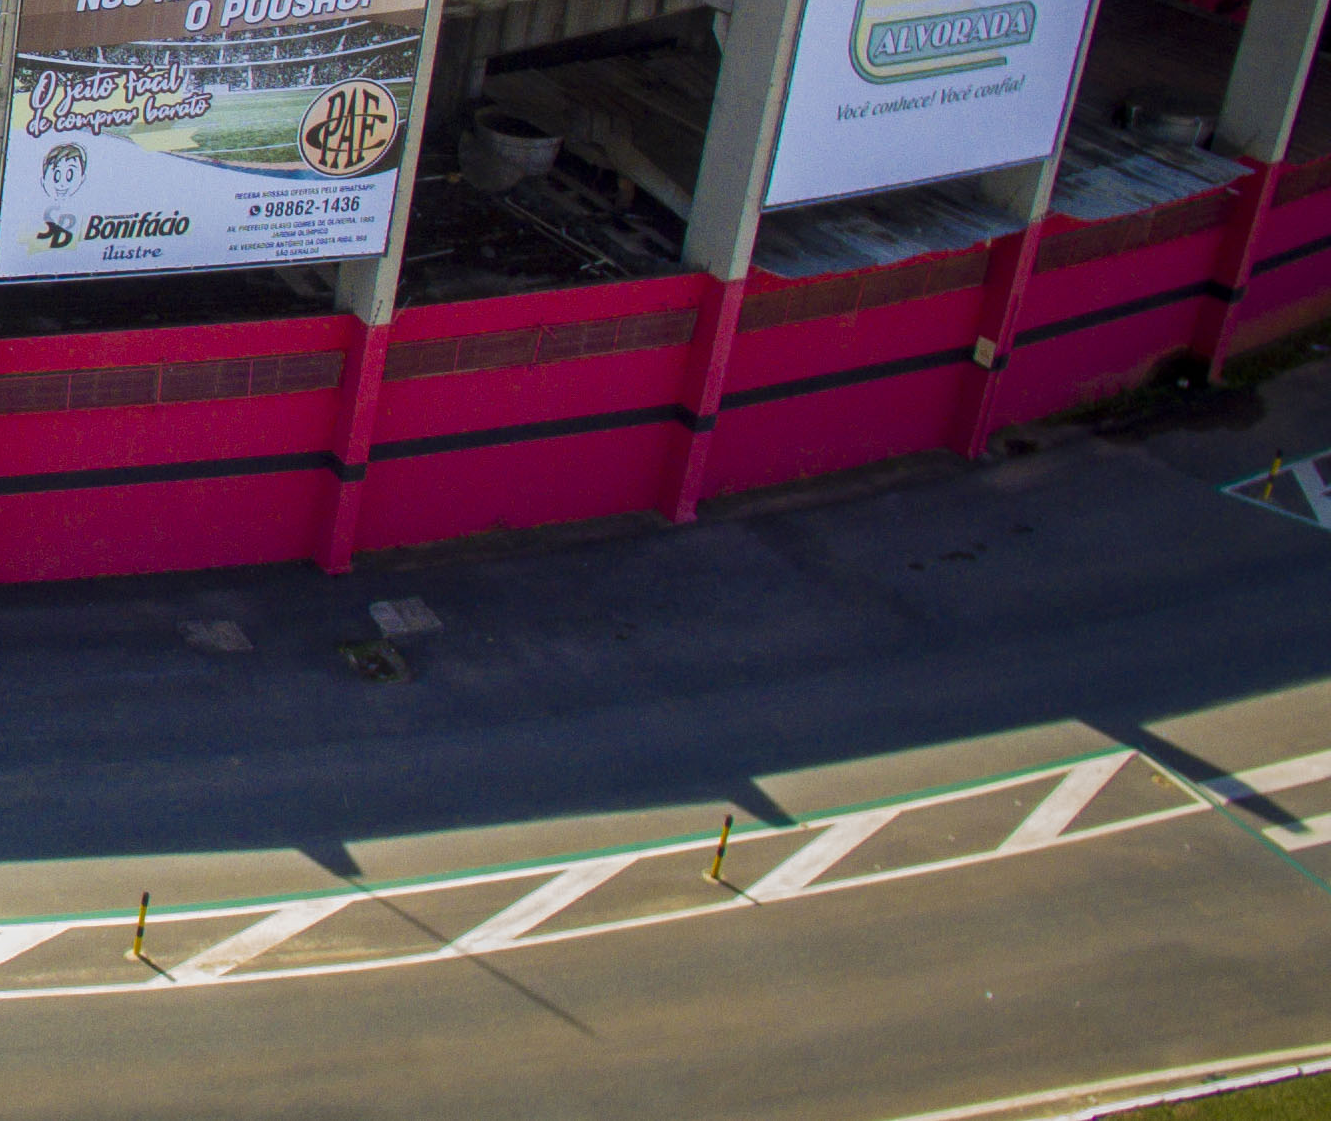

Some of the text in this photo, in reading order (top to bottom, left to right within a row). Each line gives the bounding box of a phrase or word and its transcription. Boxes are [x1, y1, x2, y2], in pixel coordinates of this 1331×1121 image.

[184, 0, 212, 31] O
[874, 7, 1028, 59] ALVORADA
[54, 71, 119, 117] jeito
[124, 63, 182, 103] fácil
[835, 74, 1026, 121] Você conhece! Você confia!
[27, 92, 213, 138] de comprar barato
[84, 210, 191, 240] Bonifácio
[265, 196, 360, 217] 98862-1436
[102, 245, 162, 261] ilustre
